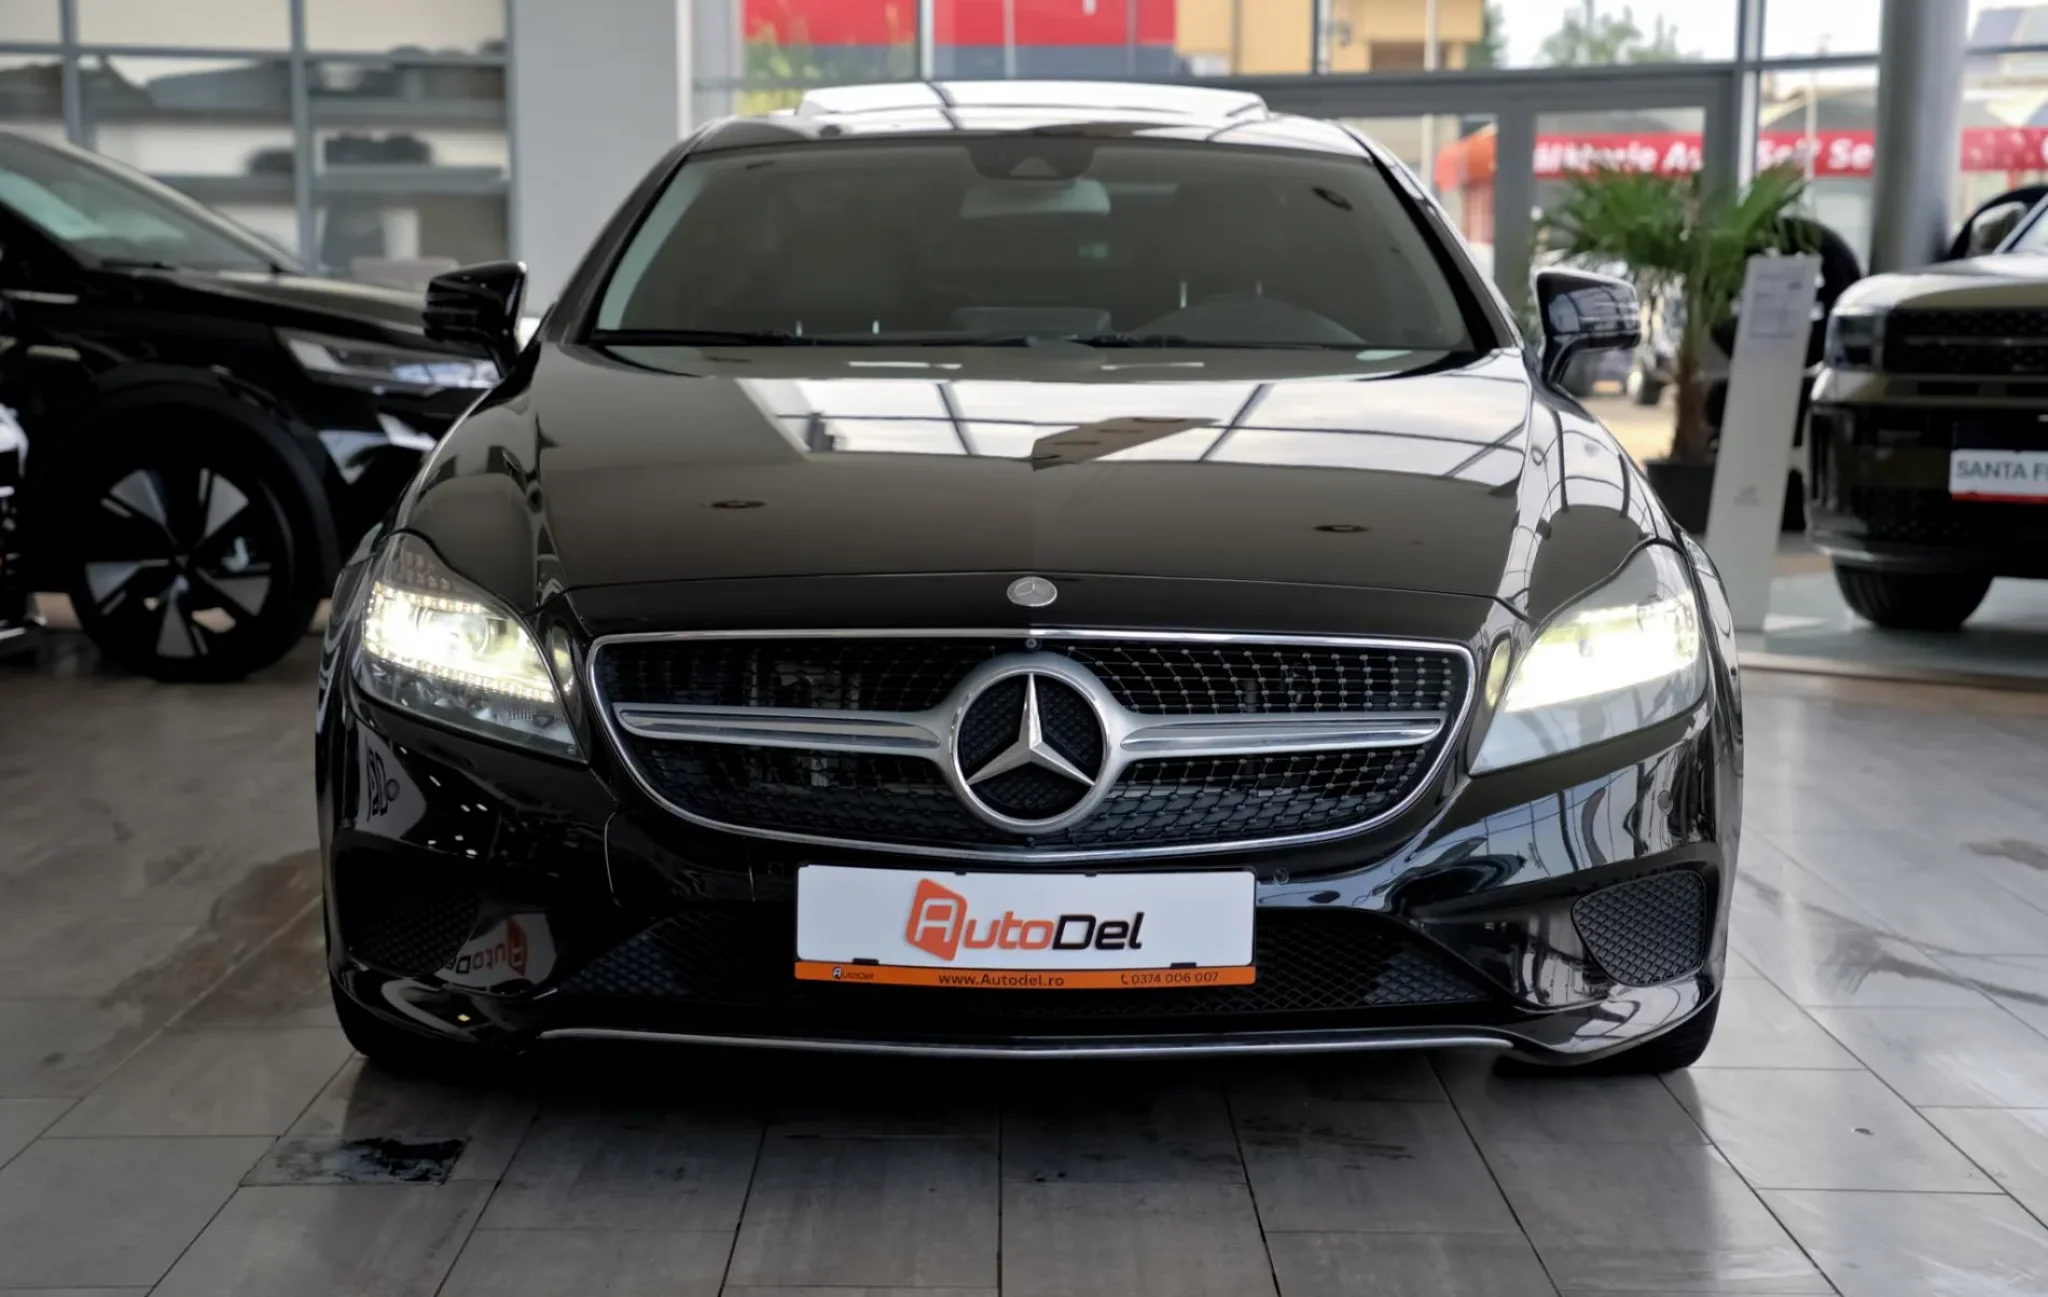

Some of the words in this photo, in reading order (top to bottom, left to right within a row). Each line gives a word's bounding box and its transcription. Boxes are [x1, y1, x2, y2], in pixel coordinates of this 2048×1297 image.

[1957, 459, 2027, 480] SANTA
[2033, 461, 2048, 483] F
[906, 878, 1145, 962] AutoDel
[938, 973, 1065, 986] www.Autodel.ro
[1131, 973, 1161, 985] 0374
[1165, 973, 1191, 984] 006
[1194, 971, 1219, 983] 007
